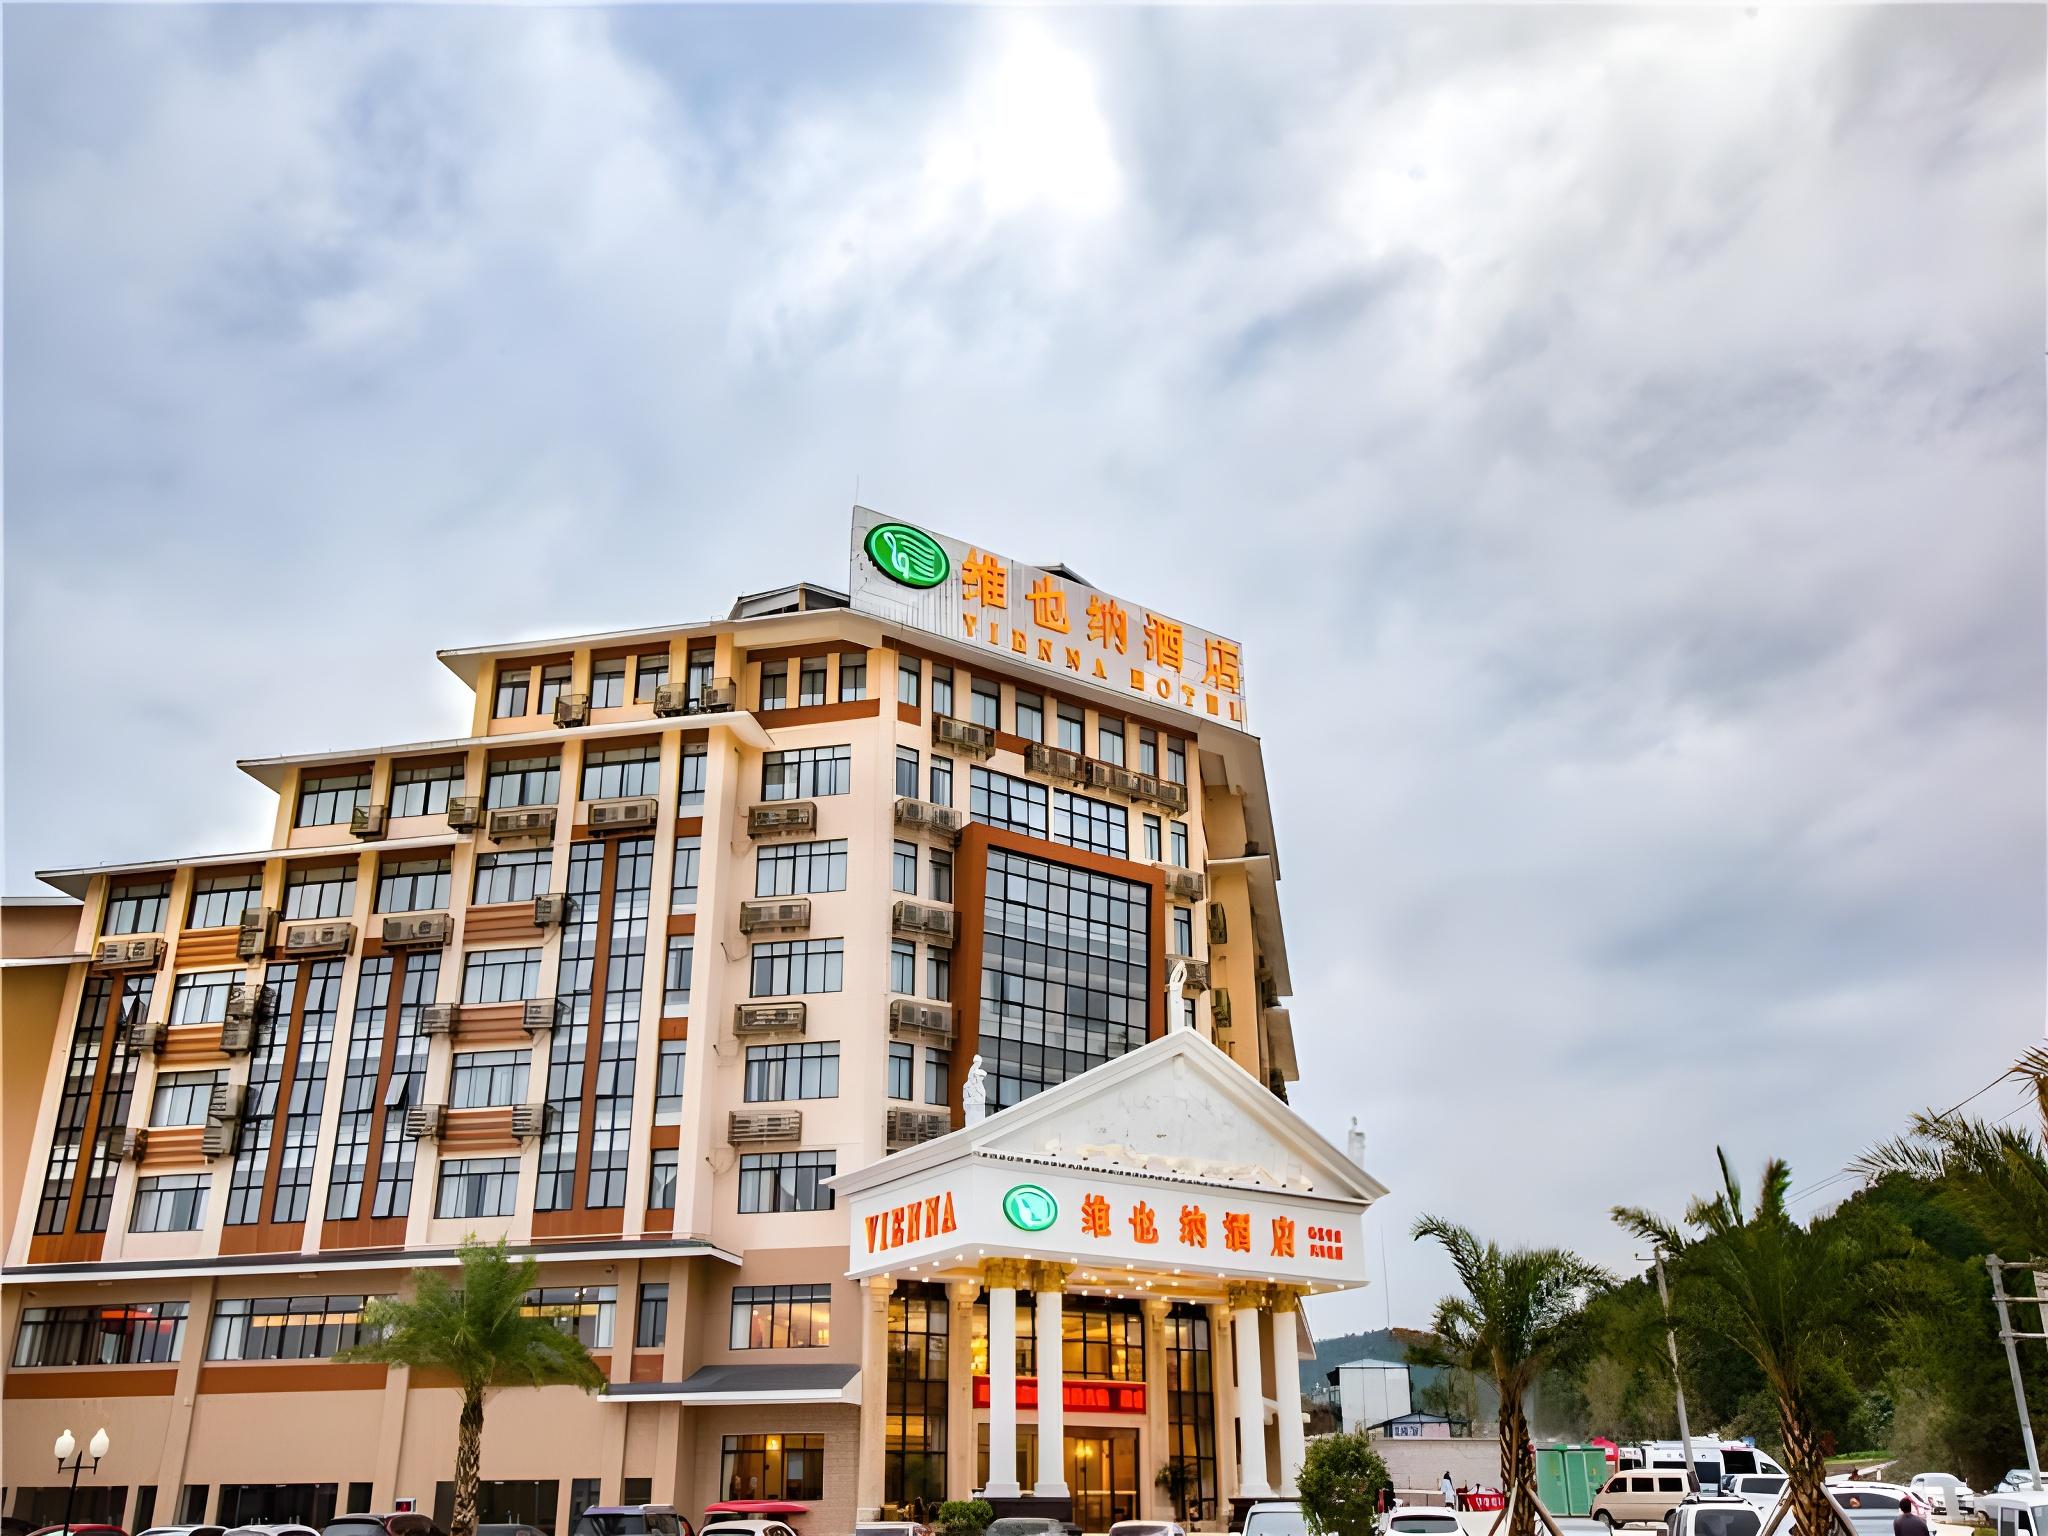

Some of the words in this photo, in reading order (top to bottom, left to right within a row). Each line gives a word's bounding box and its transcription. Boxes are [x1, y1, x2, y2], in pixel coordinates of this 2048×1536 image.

[962, 547, 1240, 693] 维也纳酒店
[1131, 668, 1241, 722] OTL
